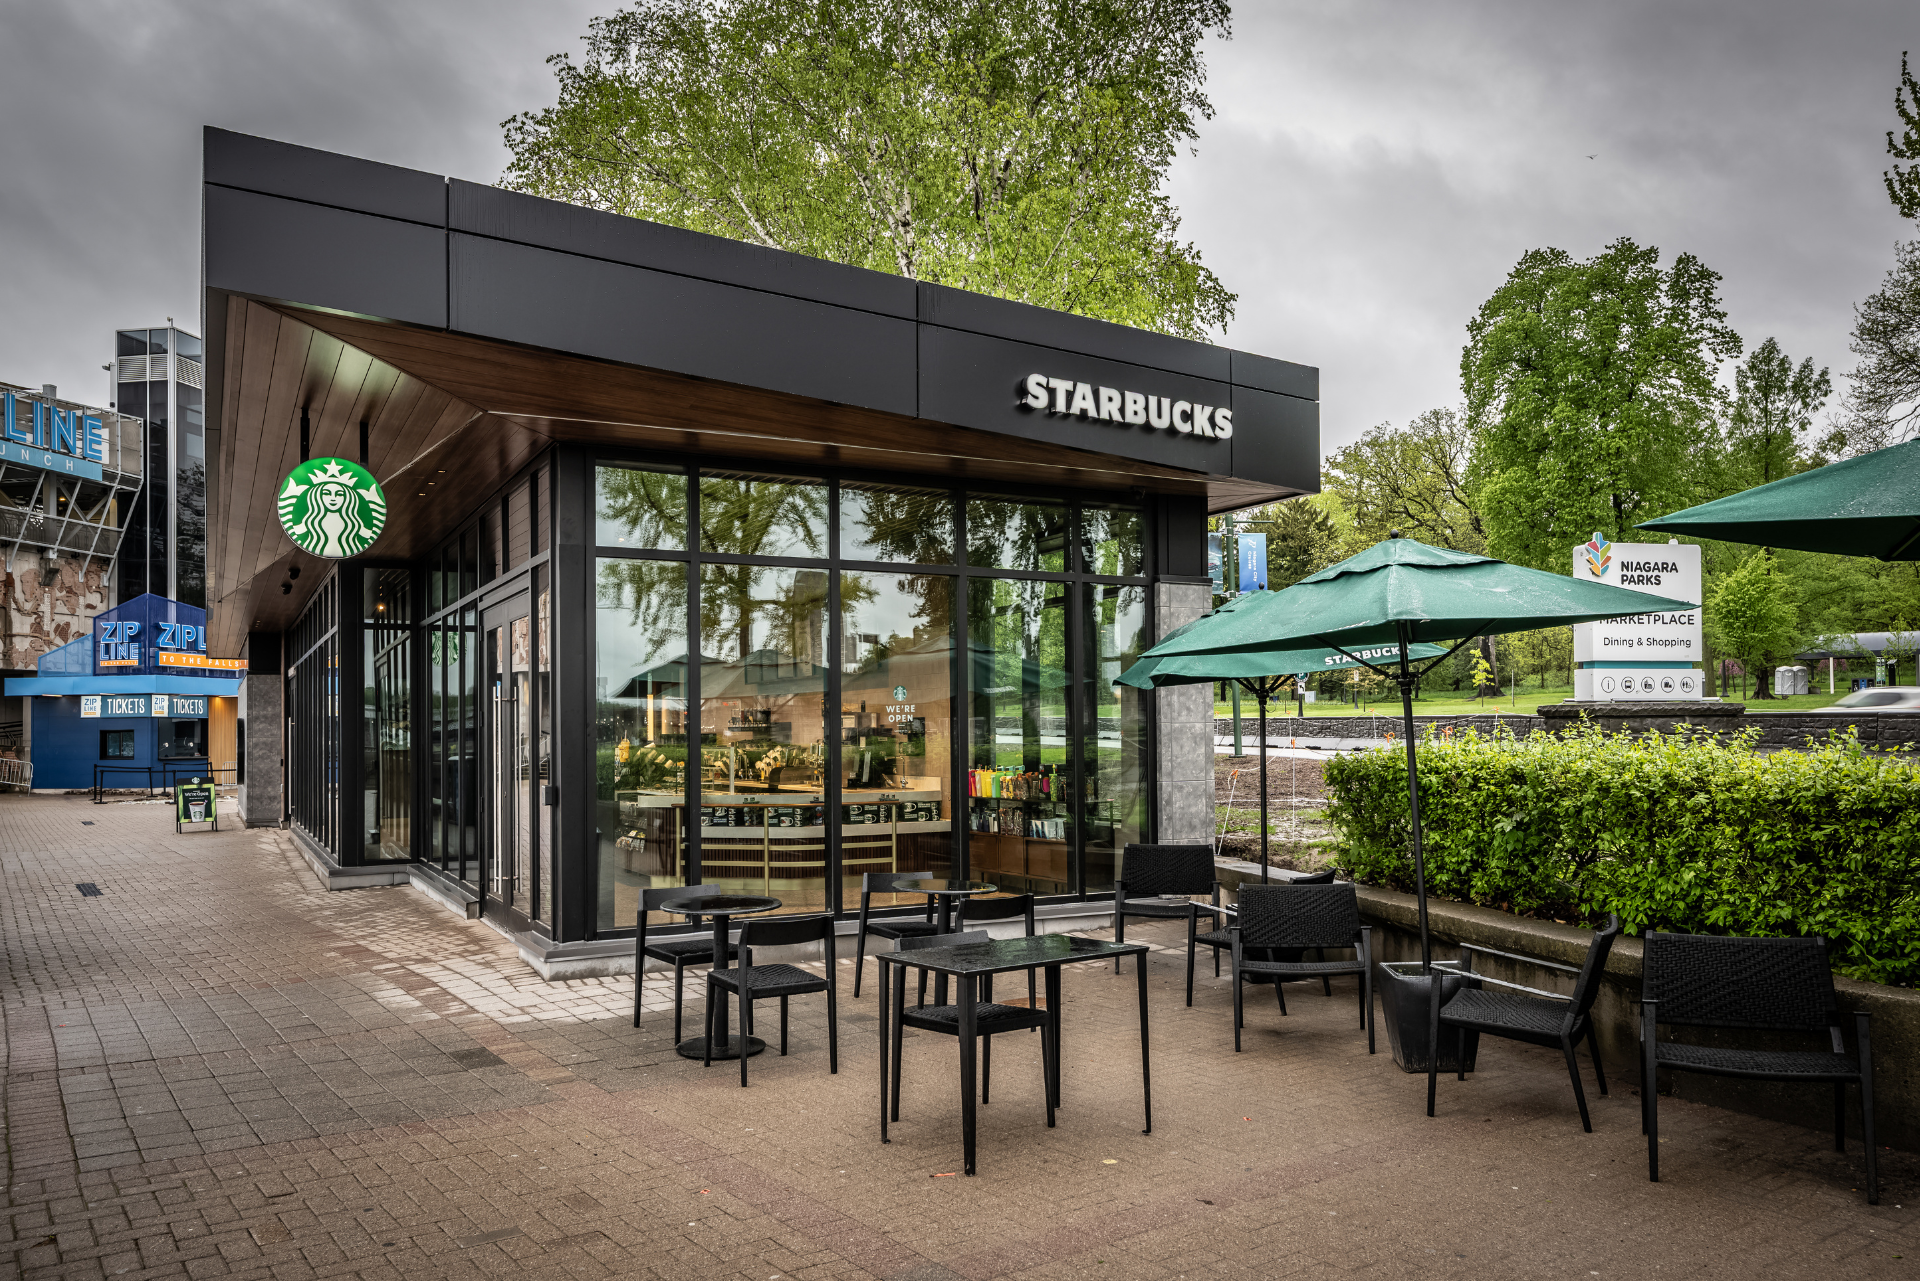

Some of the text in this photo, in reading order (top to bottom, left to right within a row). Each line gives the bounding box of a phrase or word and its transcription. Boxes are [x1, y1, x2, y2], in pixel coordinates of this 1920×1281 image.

[1024, 373, 1233, 439] STARBUCKS
[3, 392, 102, 461] LINE
[1620, 561, 1678, 573] NIAGARA
[1620, 574, 1662, 586] PARKS
[100, 621, 139, 644] ZIP
[1603, 637, 1692, 648] Dining & Shopping
[100, 643, 139, 660] LINE
[1324, 646, 1411, 666] STARBUCK
[162, 655, 239, 668] TO THE FALLS
[107, 698, 145, 714] TICKETS
[173, 698, 204, 714] TICKETS
[885, 704, 916, 713] WE'RE
[888, 714, 914, 723] OPEN
